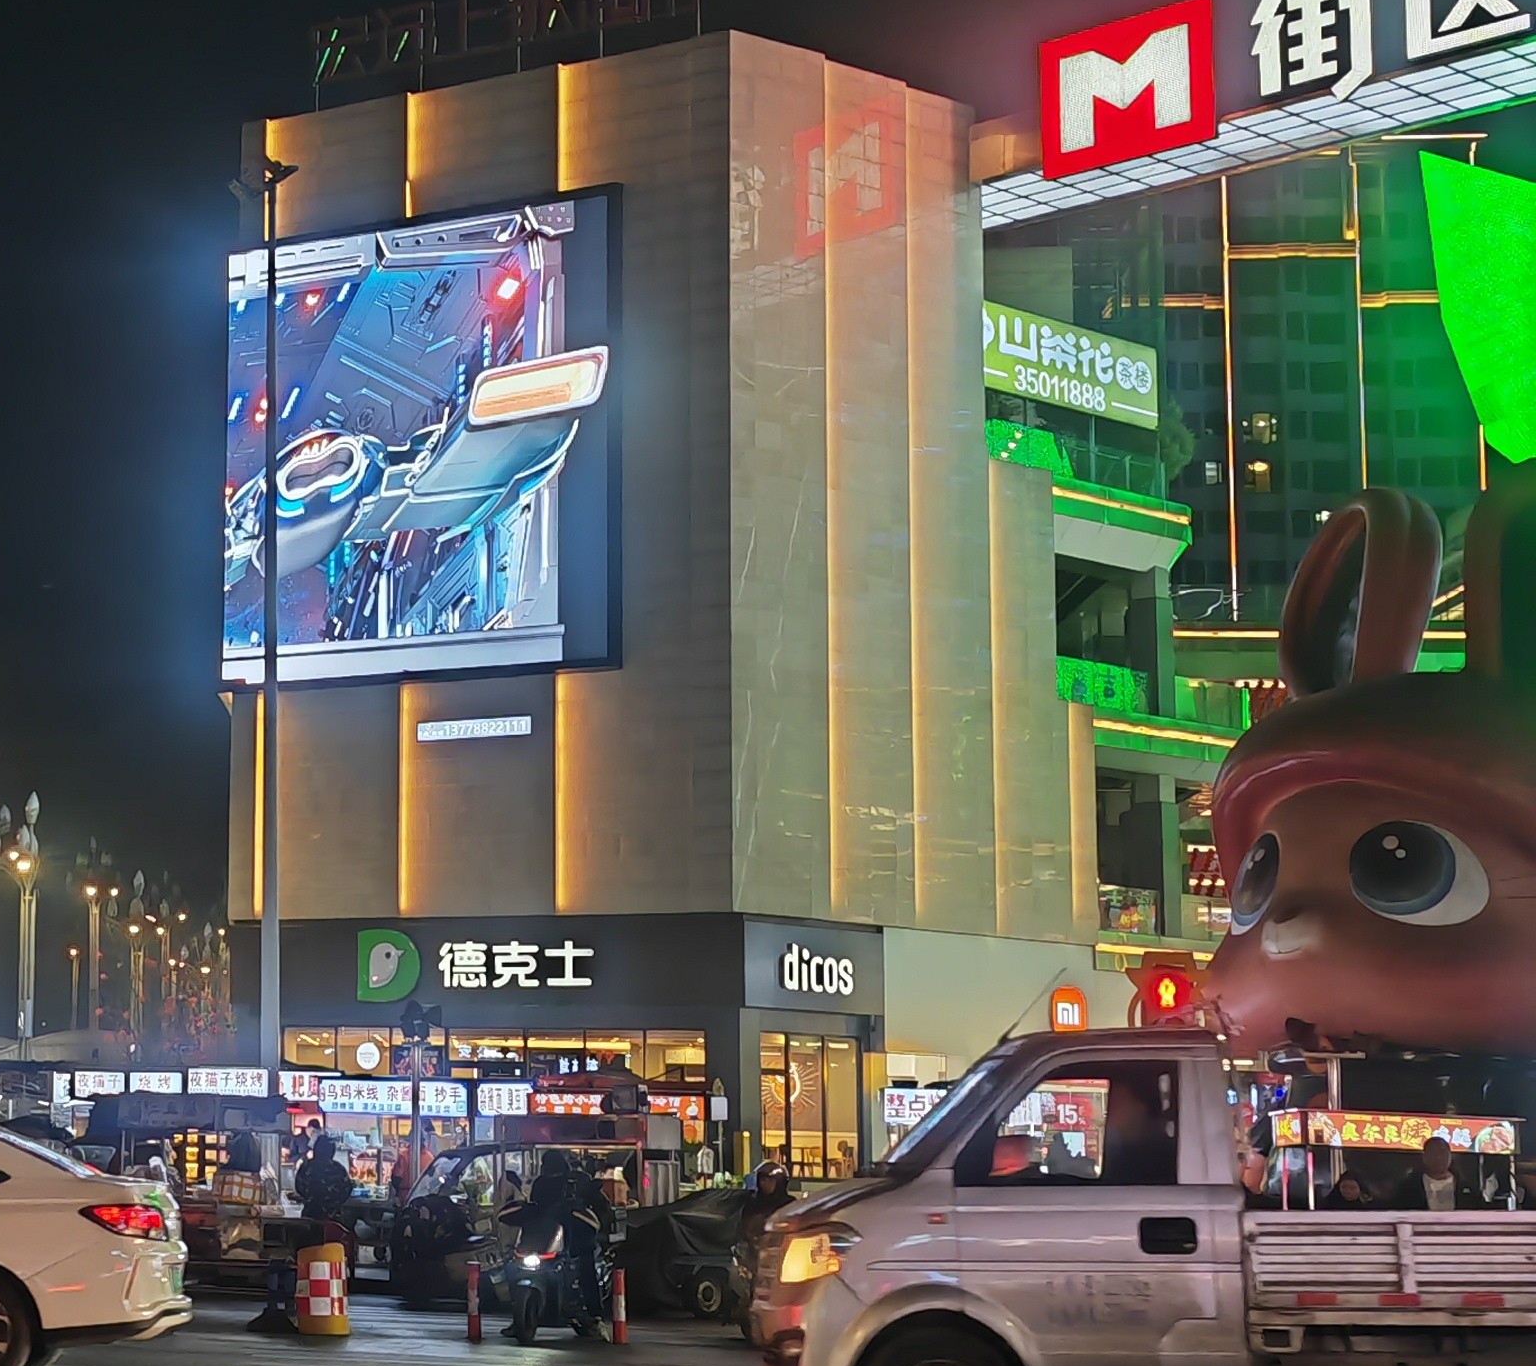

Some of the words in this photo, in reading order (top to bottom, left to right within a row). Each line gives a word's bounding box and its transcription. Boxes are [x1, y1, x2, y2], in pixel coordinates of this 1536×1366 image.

[1059, 22, 1192, 154] M
[1014, 364, 1106, 412] 35011888
[443, 719, 527, 736] 13778822111
[437, 941, 595, 989] 德克士
[782, 942, 854, 996] dicos
[77, 1073, 121, 1088] 夜猫子
[189, 1071, 264, 1088] 夜猫子烧烤
